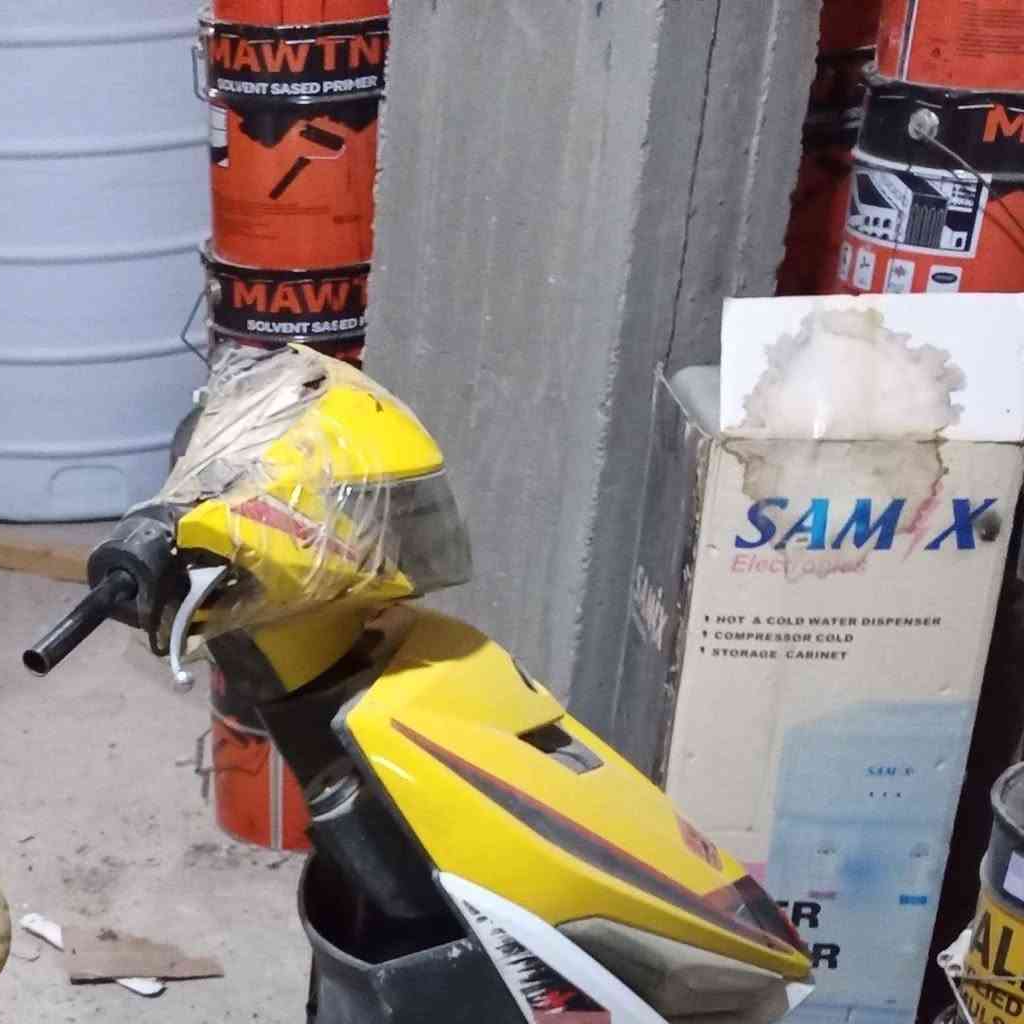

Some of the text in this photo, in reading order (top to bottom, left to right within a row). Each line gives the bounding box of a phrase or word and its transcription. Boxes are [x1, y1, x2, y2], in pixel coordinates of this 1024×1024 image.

[322, 75, 378, 93] PRIMER
[247, 319, 310, 334] SOLVENT
[766, 616, 805, 626] COLD
[809, 617, 857, 626] WATER
[861, 616, 942, 627] DISPENSER
[714, 631, 854, 643] COMPRESSOR COLD
[711, 647, 848, 661] STORAGE CABINET
[776, 901, 822, 928] R
